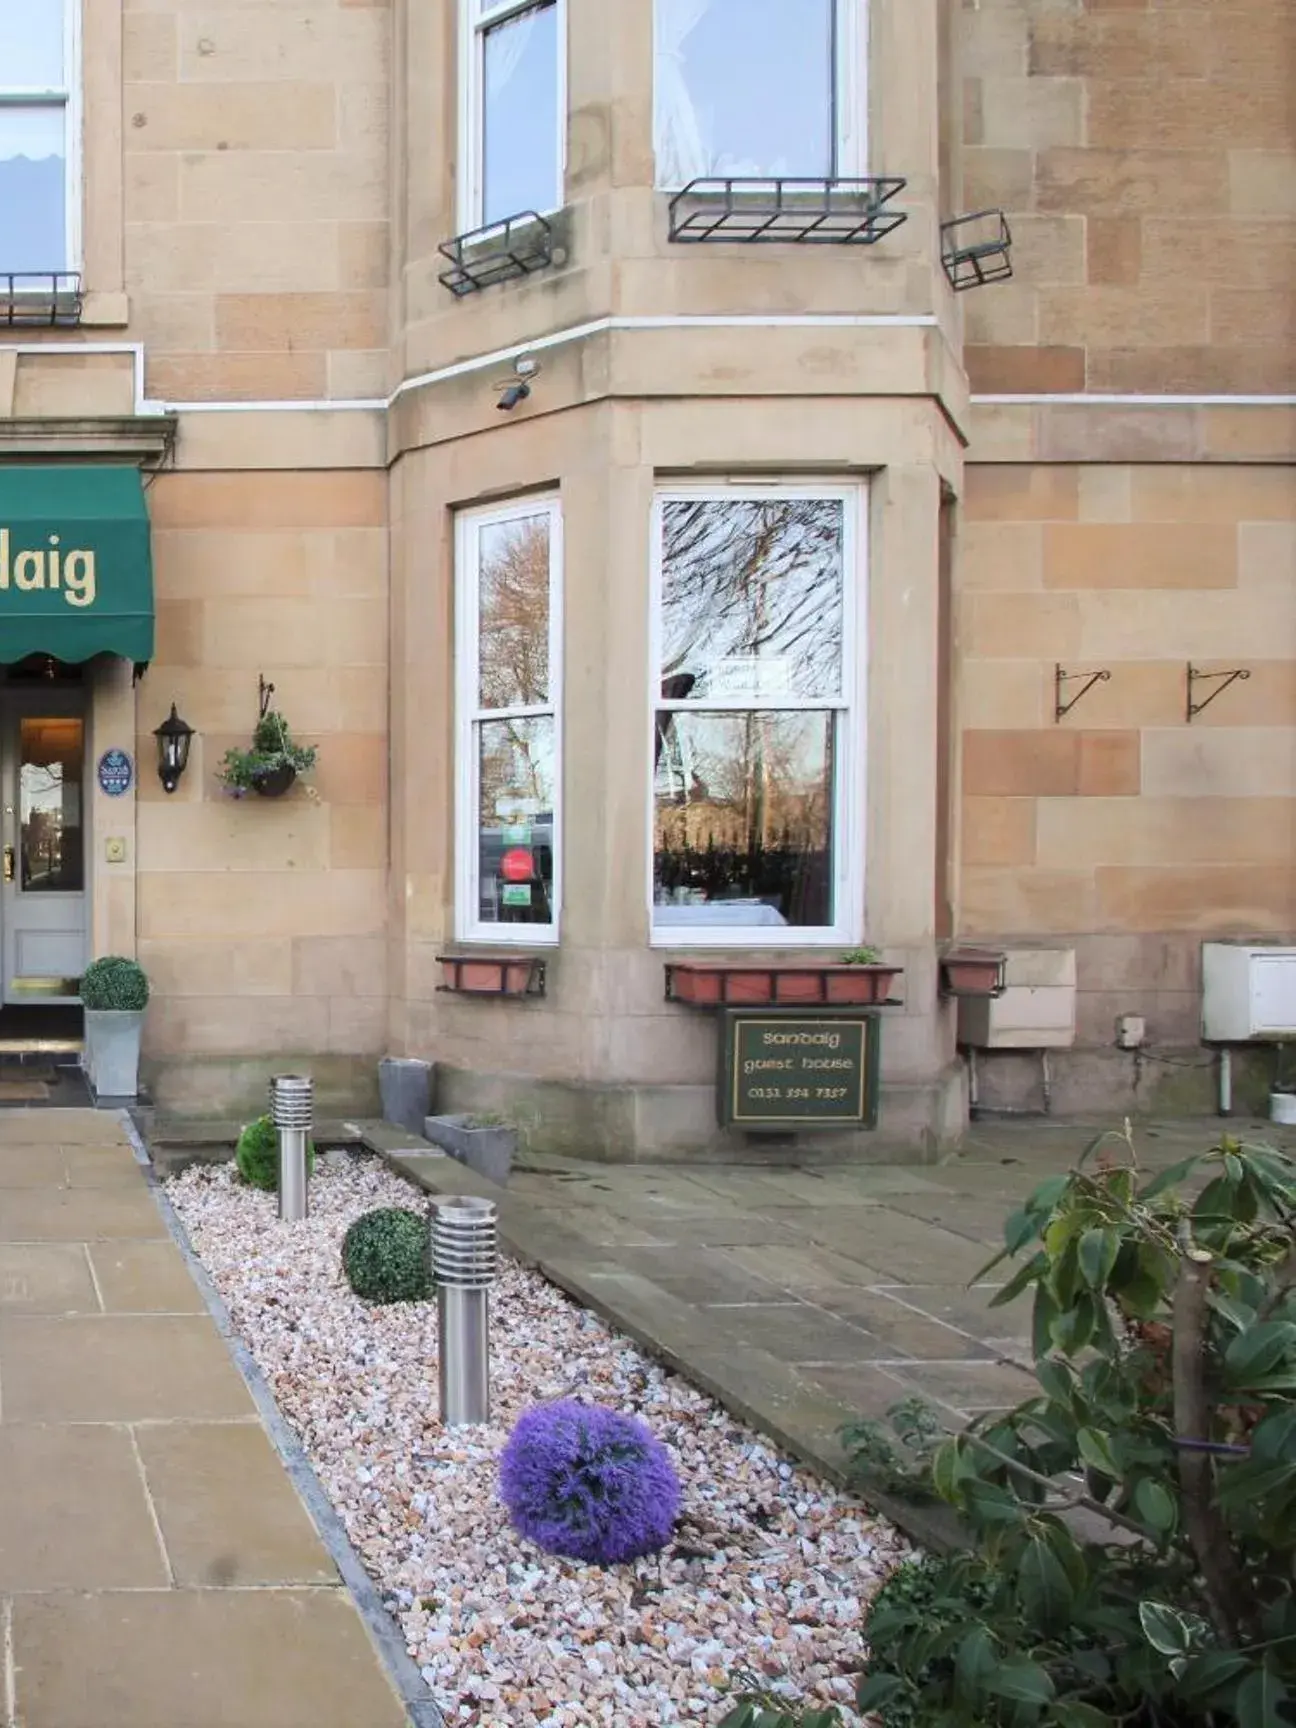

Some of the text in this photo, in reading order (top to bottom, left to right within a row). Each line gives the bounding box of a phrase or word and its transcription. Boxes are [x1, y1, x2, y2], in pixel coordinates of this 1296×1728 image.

[744, 1057, 853, 1074] guest house
[747, 1087, 782, 1099] 0131
[815, 1087, 847, 1099] 7357
